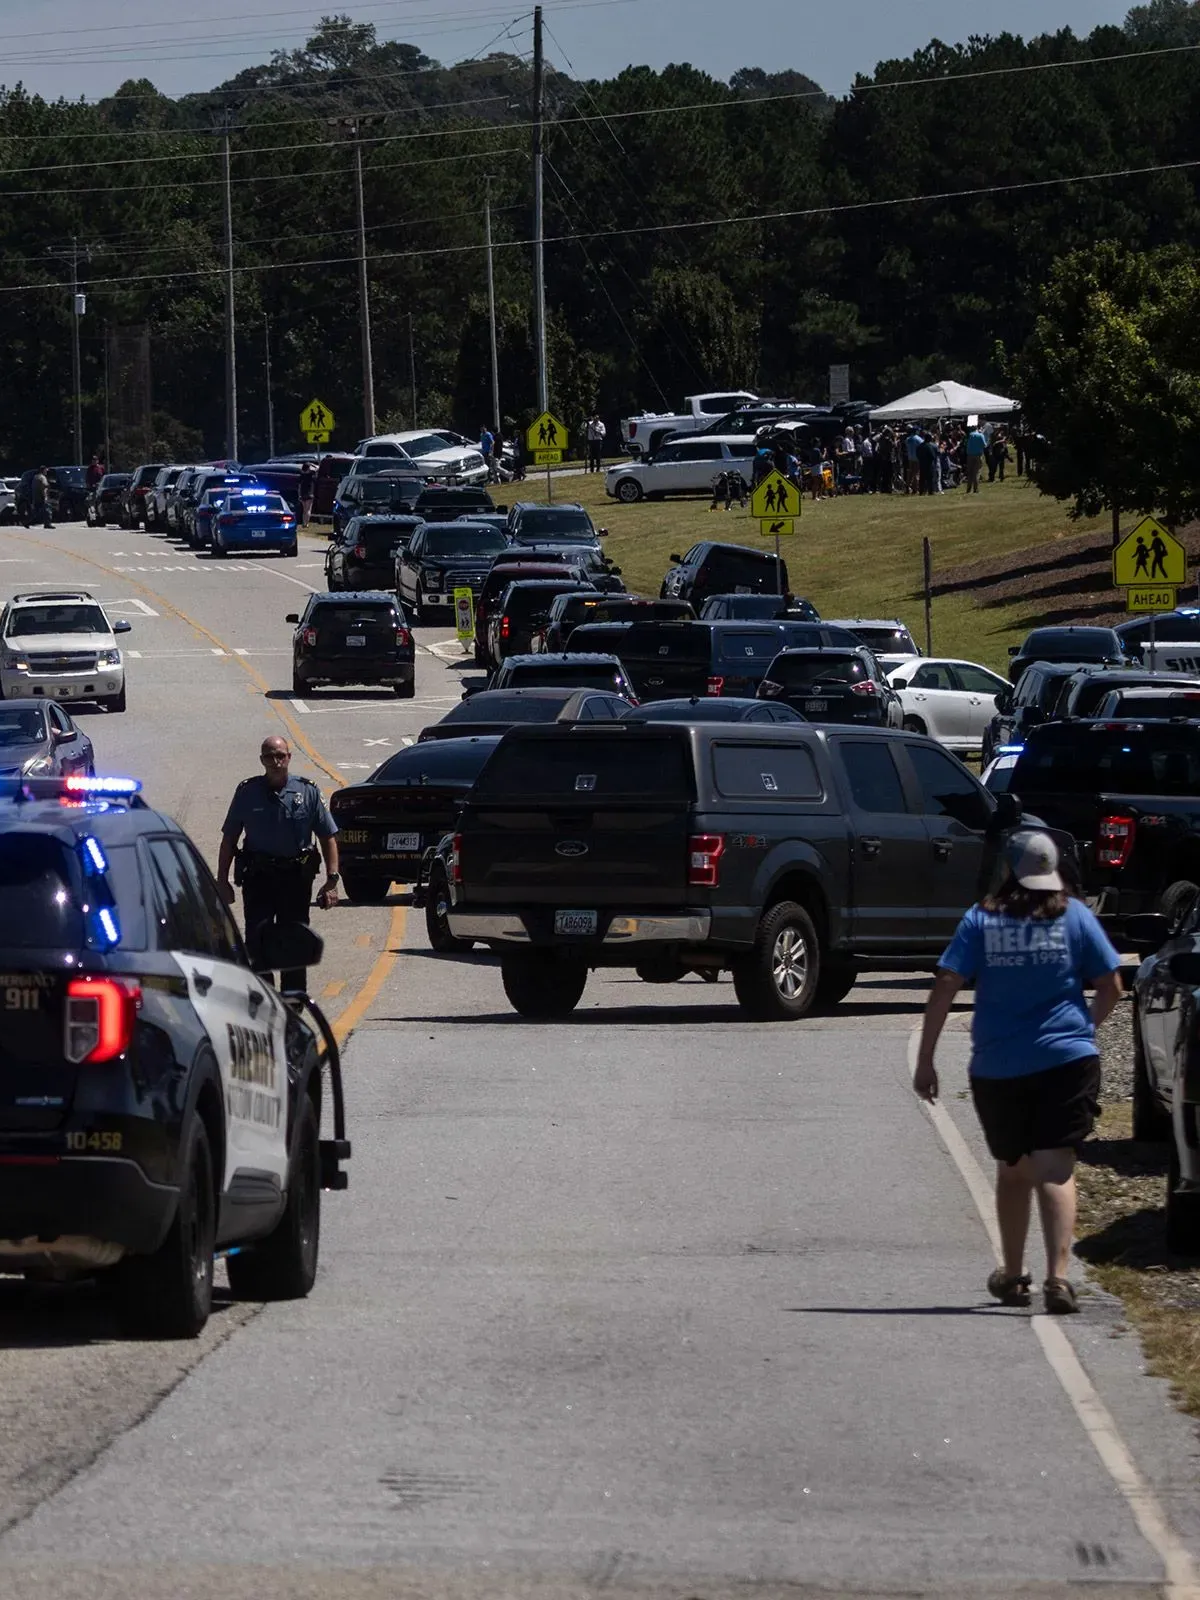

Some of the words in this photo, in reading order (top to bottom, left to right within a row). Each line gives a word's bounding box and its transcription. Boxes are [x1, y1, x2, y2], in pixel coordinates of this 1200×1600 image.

[1133, 593, 1170, 605] AHEAD
[336, 829, 369, 844] HERIFF
[986, 953, 1025, 967] Since
[4, 988, 40, 1010] 911
[65, 1131, 123, 1150] 10458
